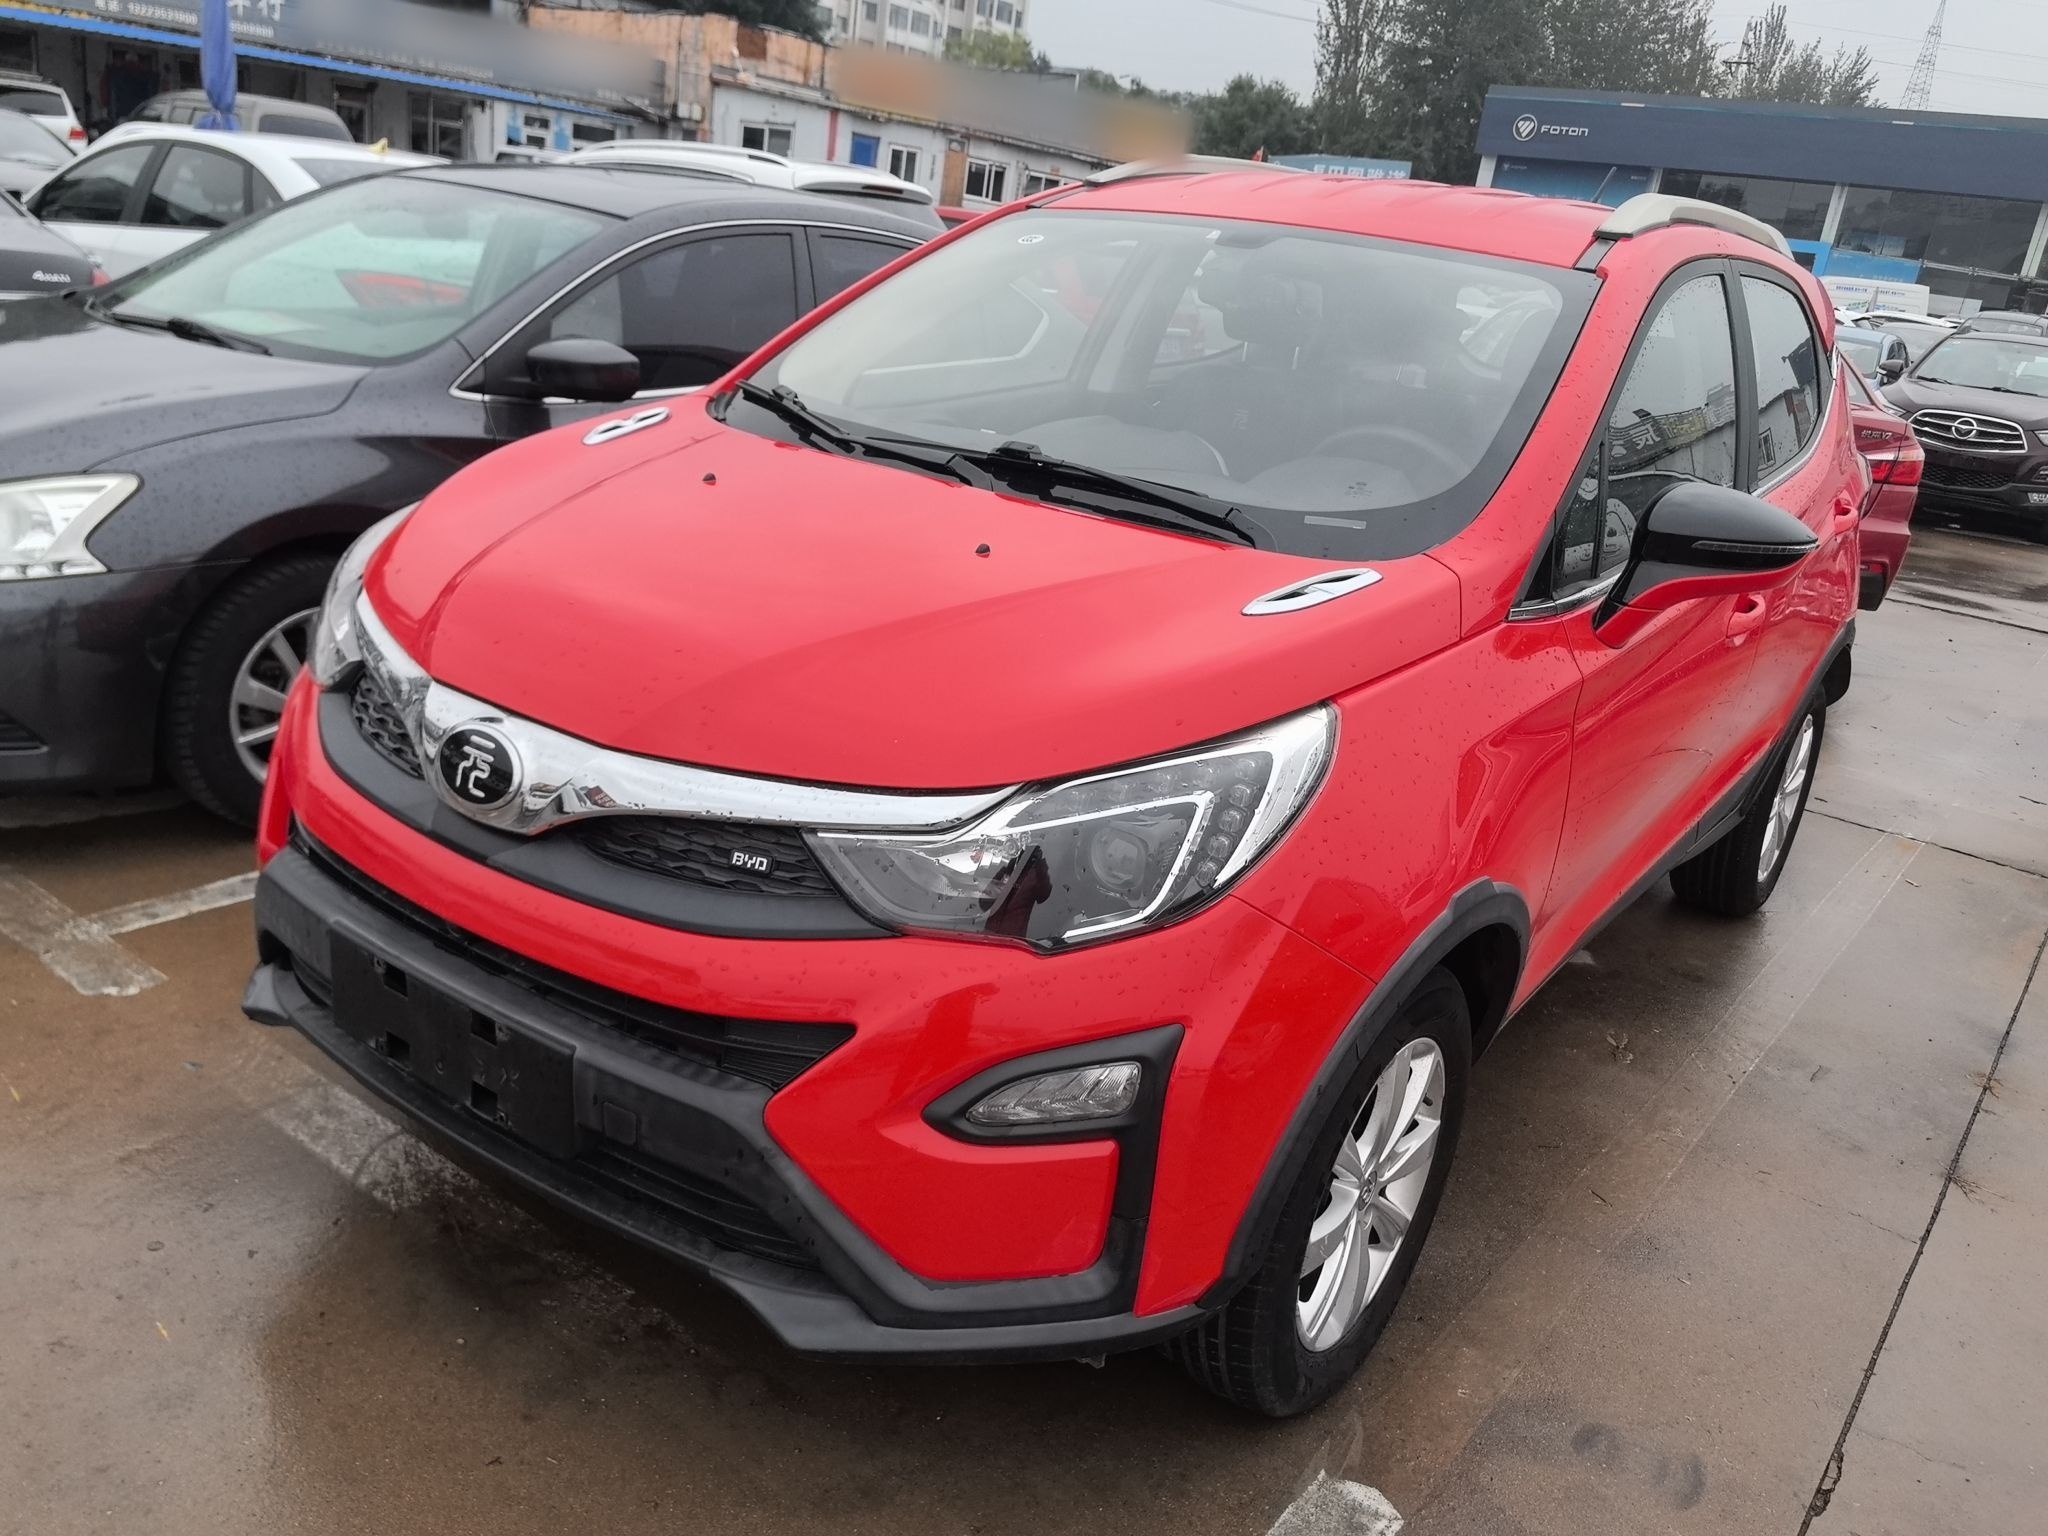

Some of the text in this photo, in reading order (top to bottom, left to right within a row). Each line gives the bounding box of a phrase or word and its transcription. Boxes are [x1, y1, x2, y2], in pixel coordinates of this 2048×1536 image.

[1540, 124, 1589, 137] FOTON
[456, 734, 496, 798] 元
[731, 851, 768, 871] BYD
